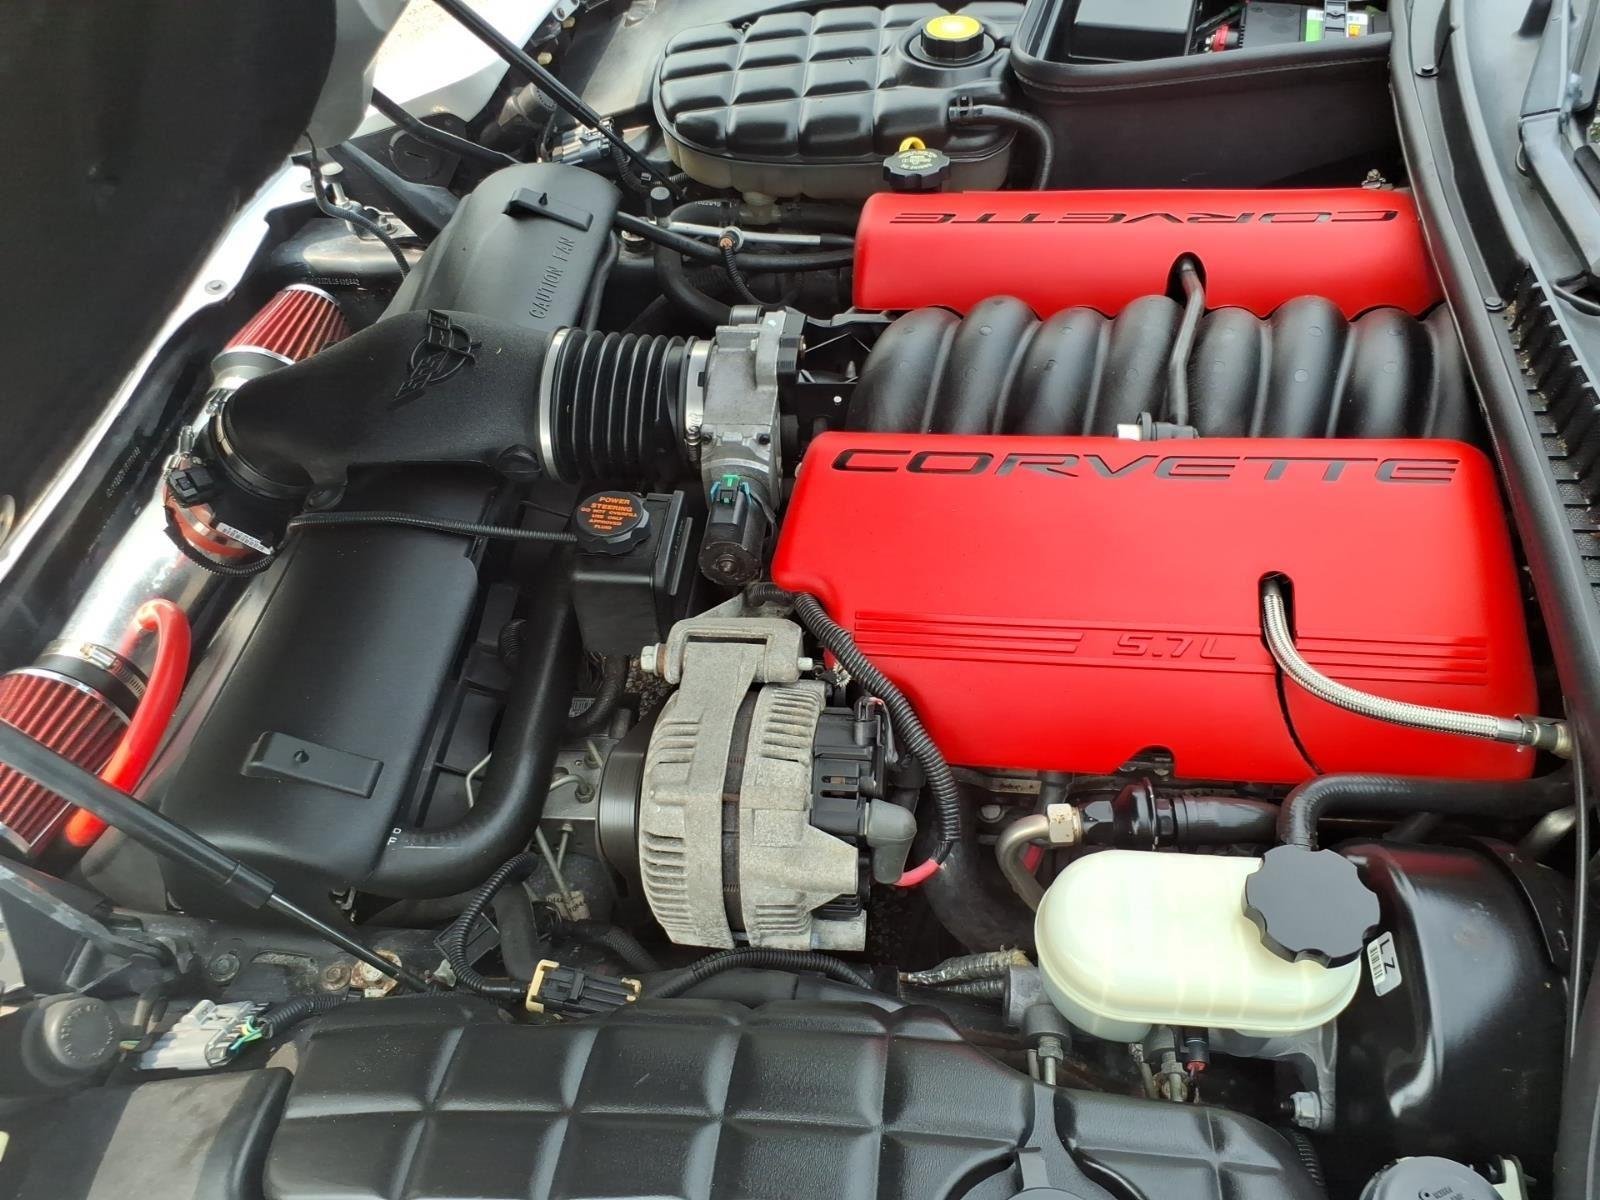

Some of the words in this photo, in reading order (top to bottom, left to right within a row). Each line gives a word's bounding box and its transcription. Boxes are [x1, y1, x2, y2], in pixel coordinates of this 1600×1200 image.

[889, 210, 1399, 224] CORVETTE
[528, 265, 564, 319] CAUTION
[552, 235, 576, 262] FAN
[832, 449, 1459, 484] CORVETTE
[590, 502, 633, 512] STEERING
[599, 496, 631, 505] POWER
[1112, 632, 1237, 661] 5.7L
